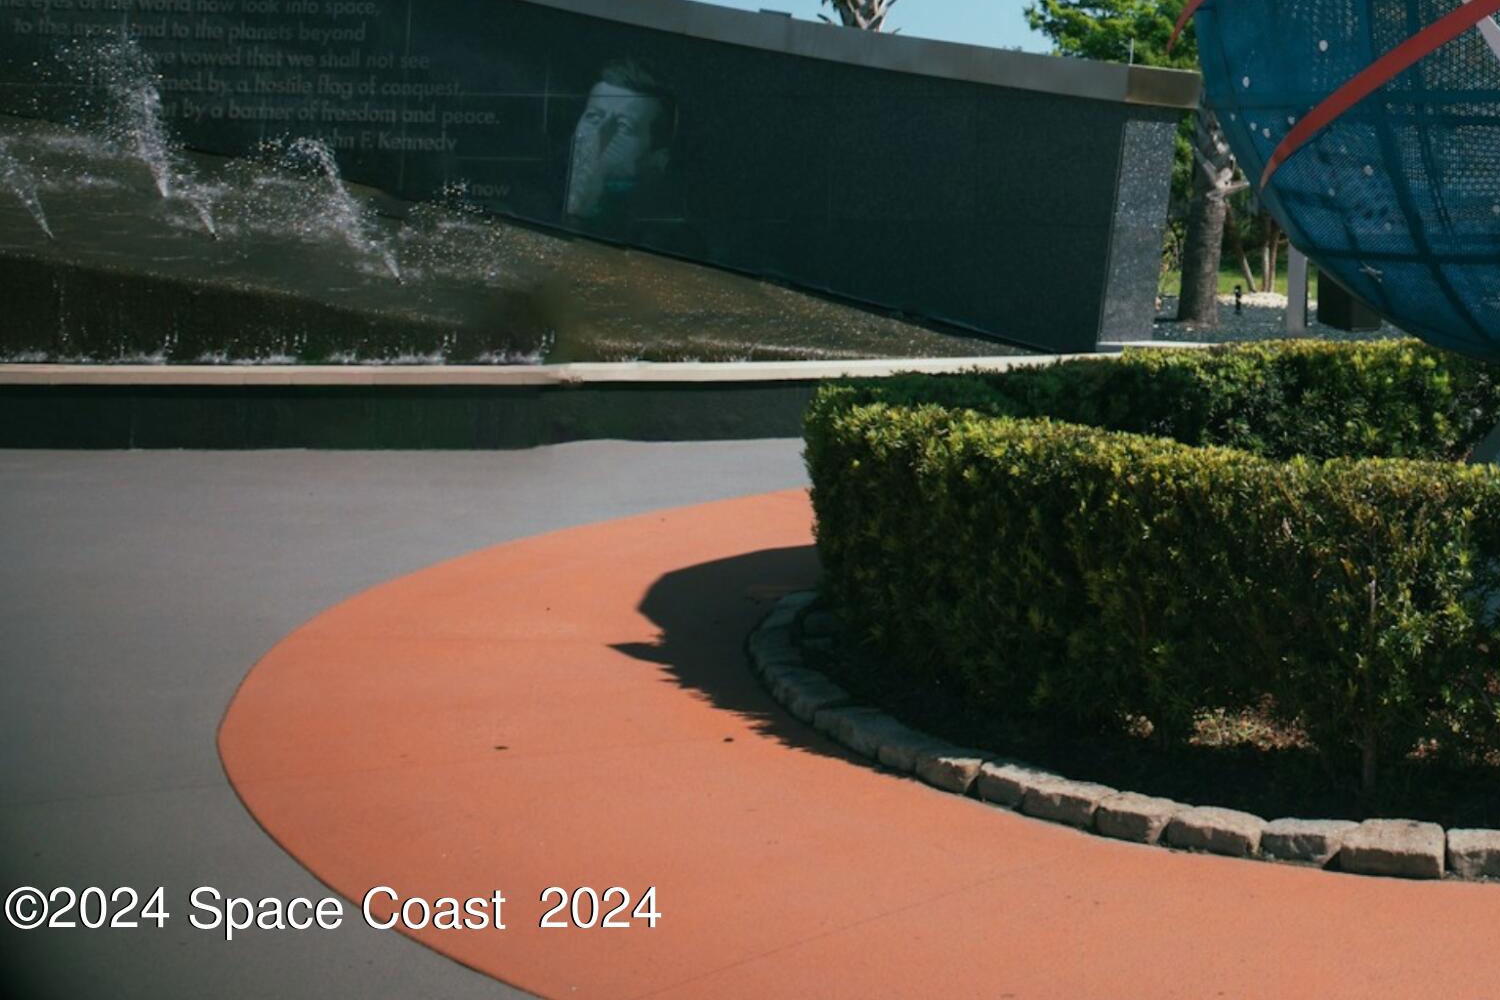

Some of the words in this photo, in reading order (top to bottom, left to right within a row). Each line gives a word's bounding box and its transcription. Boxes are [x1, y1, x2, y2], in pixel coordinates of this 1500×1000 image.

[196, 0, 235, 13] now
[325, 0, 382, 20] space,
[14, 17, 33, 35] to
[38, 15, 67, 36] the
[171, 21, 190, 39] to
[194, 18, 224, 39] the
[228, 20, 294, 44] planets
[299, 20, 367, 46] beyond
[180, 46, 241, 67] vowed
[246, 46, 282, 68] that
[286, 54, 316, 68] we
[319, 48, 361, 69] shall
[366, 52, 394, 69] not
[400, 54, 431, 69] see
[237, 80, 250, 92] a
[255, 73, 313, 95] hostile
[317, 74, 353, 100] flag
[358, 74, 377, 96] of
[182, 98, 205, 122] by
[210, 107, 223, 119] a
[228, 98, 291, 120] banner
[297, 98, 318, 121] of
[320, 100, 397, 123] freedom
[402, 103, 437, 123] and
[442, 110, 501, 130] peace.
[379, 130, 457, 151] Kennedy
